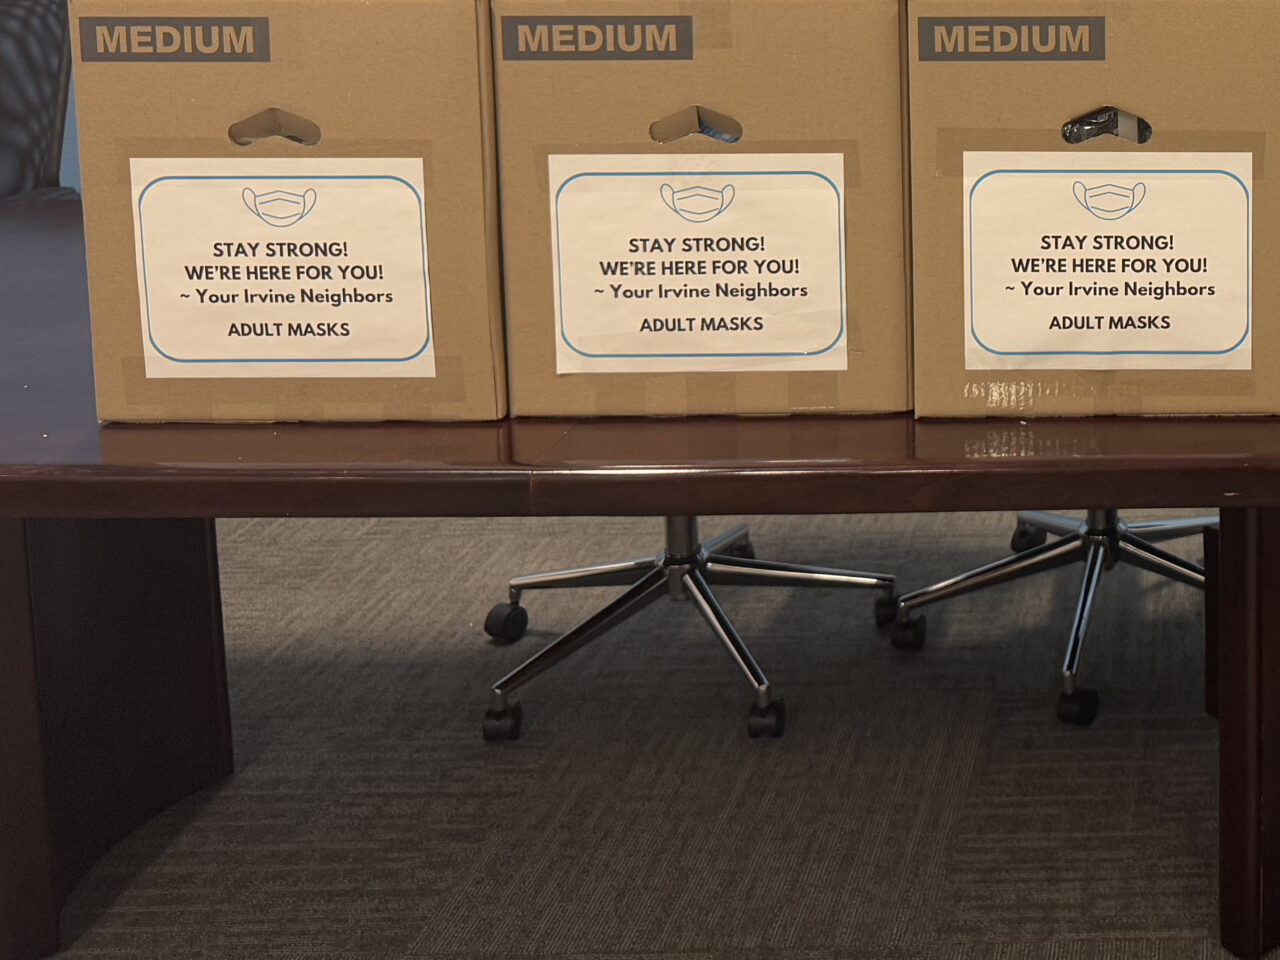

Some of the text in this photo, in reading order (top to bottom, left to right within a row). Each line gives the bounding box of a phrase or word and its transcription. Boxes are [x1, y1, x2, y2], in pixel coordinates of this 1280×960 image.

[96, 26, 255, 55] MEDIUM
[518, 25, 678, 54] MEDIUM
[935, 25, 1091, 54] MEDIUM
[213, 241, 348, 258] STAY STRONG!
[628, 235, 765, 254] STAY STRONG!
[1040, 234, 1174, 251] STAY STRONG!
[184, 264, 384, 281] WE'RE HERE FOR YOU!
[598, 258, 800, 276] WE'RE HERE FOR YOU!
[1010, 257, 1208, 274] WE'RE HERE FOR YOU!
[195, 288, 240, 304] Your
[243, 288, 296, 304] Irvine
[300, 287, 394, 308] Neighbors
[609, 283, 654, 299] Your
[658, 283, 711, 299] Irvine
[715, 281, 808, 302] Neighbors
[1020, 280, 1065, 296] Your
[1068, 281, 1120, 297] Irvine
[1124, 280, 1216, 301] Neighbors
[227, 322, 351, 337] ADULT MASKS
[639, 316, 764, 333] ADULT MASKS
[1048, 315, 1171, 330] ADULT MASKS
